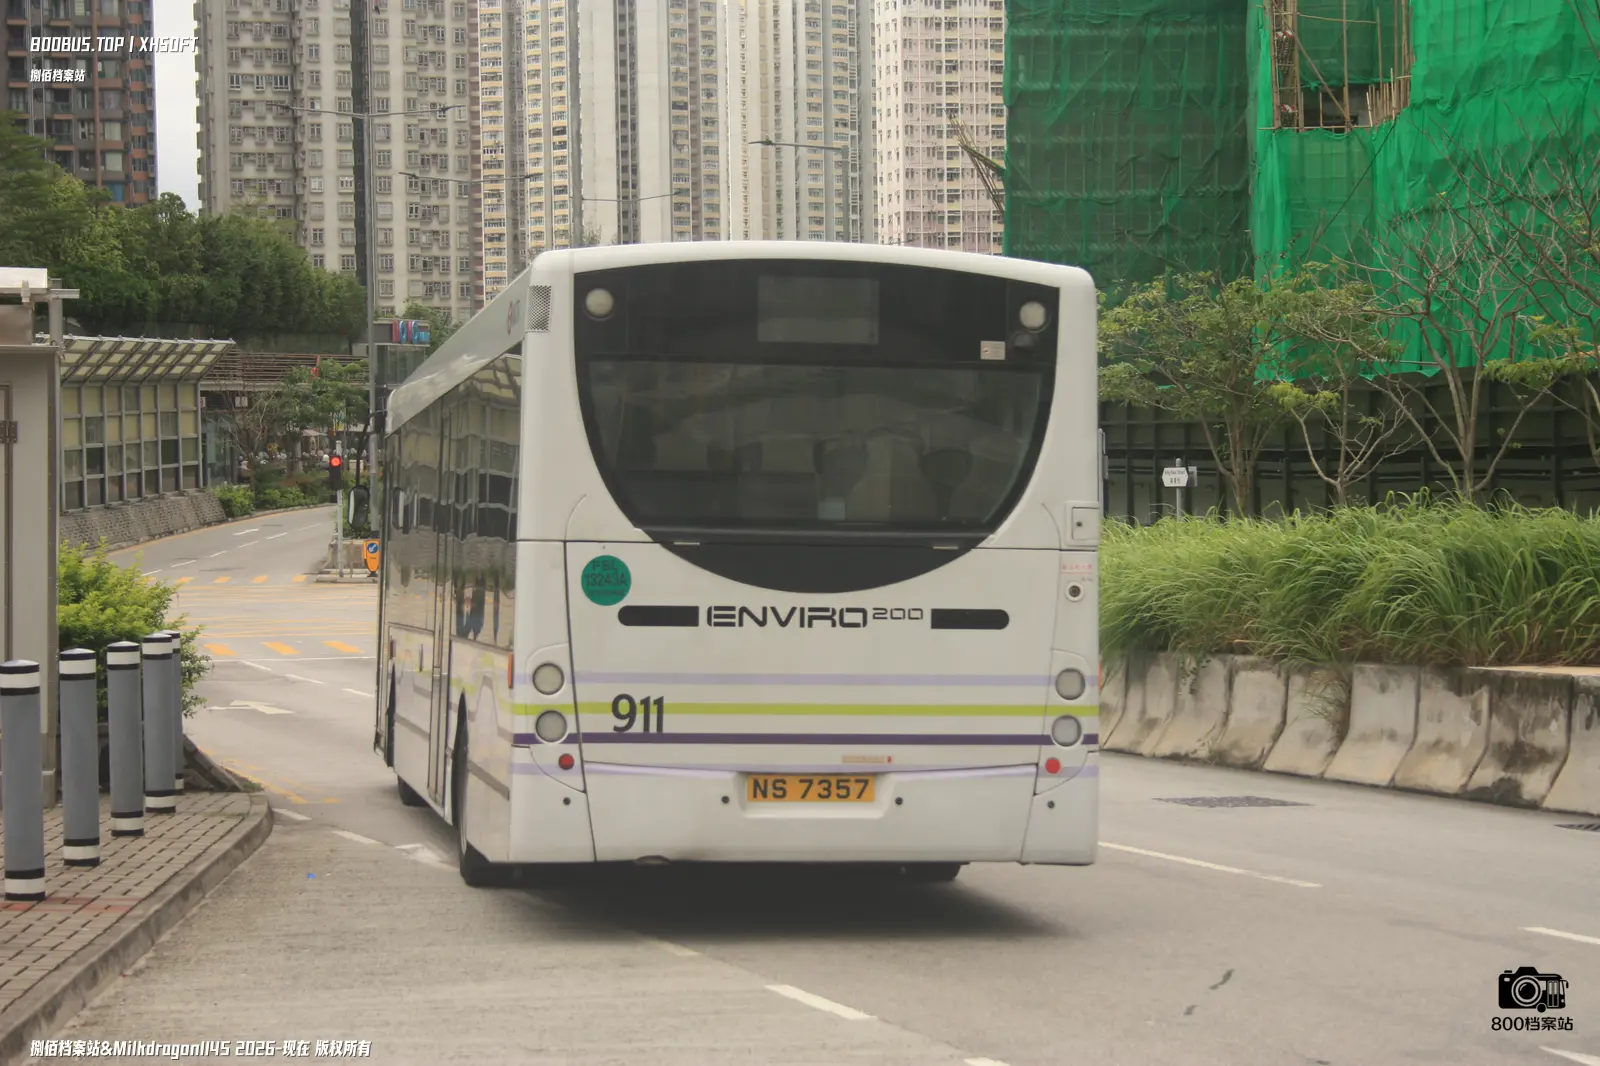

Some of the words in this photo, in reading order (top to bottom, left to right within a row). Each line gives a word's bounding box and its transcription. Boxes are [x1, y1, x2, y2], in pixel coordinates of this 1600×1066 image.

[706, 605, 868, 628] ENVIRO
[872, 607, 924, 620] 200
[611, 693, 664, 733] 911
[752, 778, 788, 800] NS
[798, 778, 869, 800] 7357
